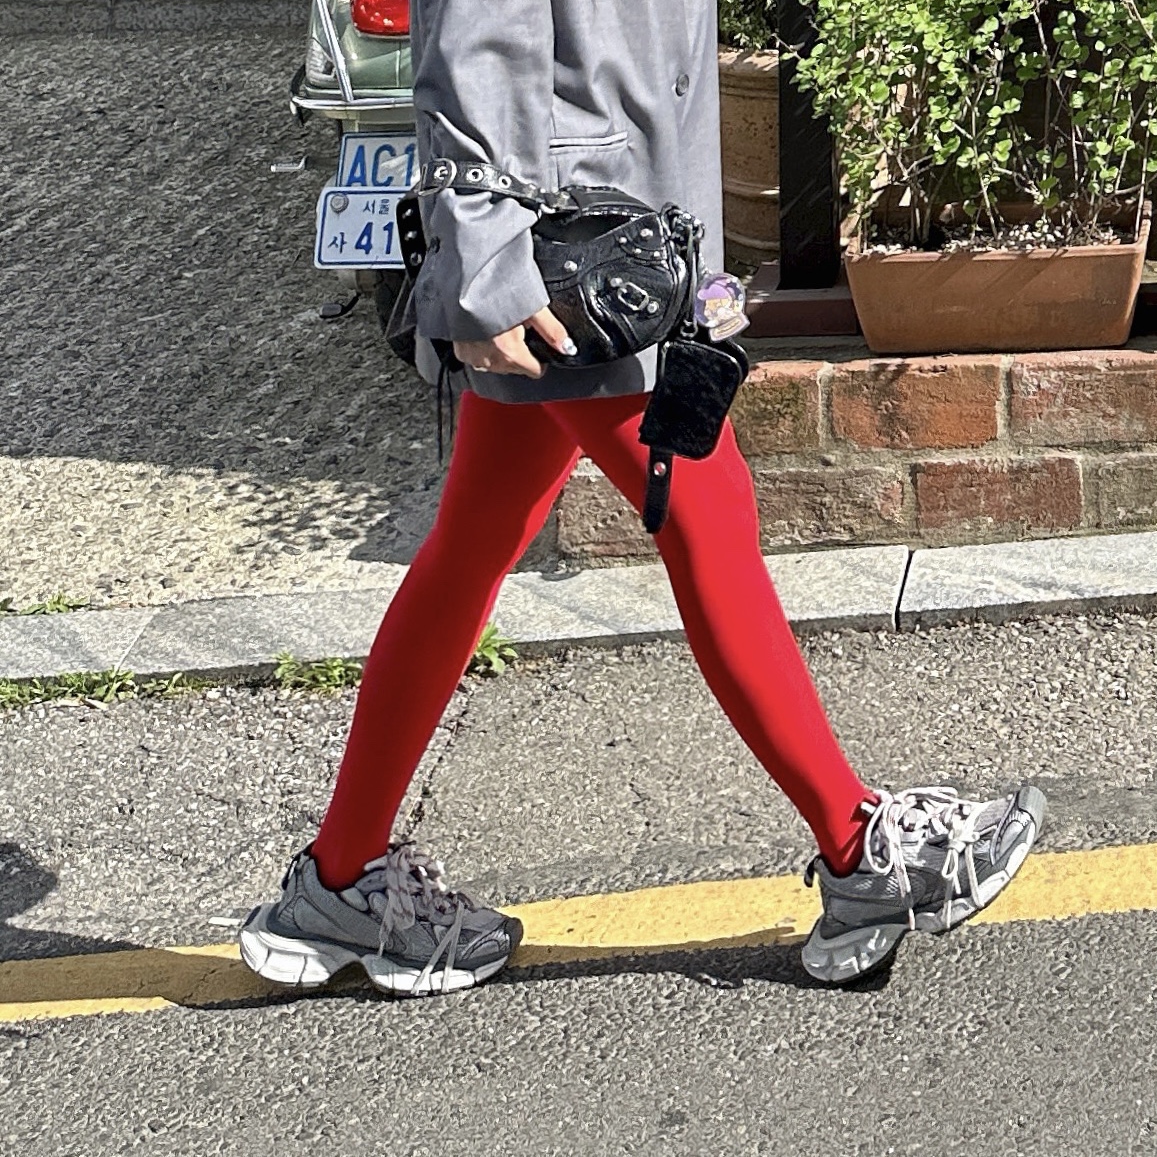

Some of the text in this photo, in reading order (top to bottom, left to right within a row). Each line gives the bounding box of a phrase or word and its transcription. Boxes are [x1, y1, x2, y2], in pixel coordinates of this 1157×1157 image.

[362, 199, 390, 215] 서울
[327, 221, 394, 254] 사 41
